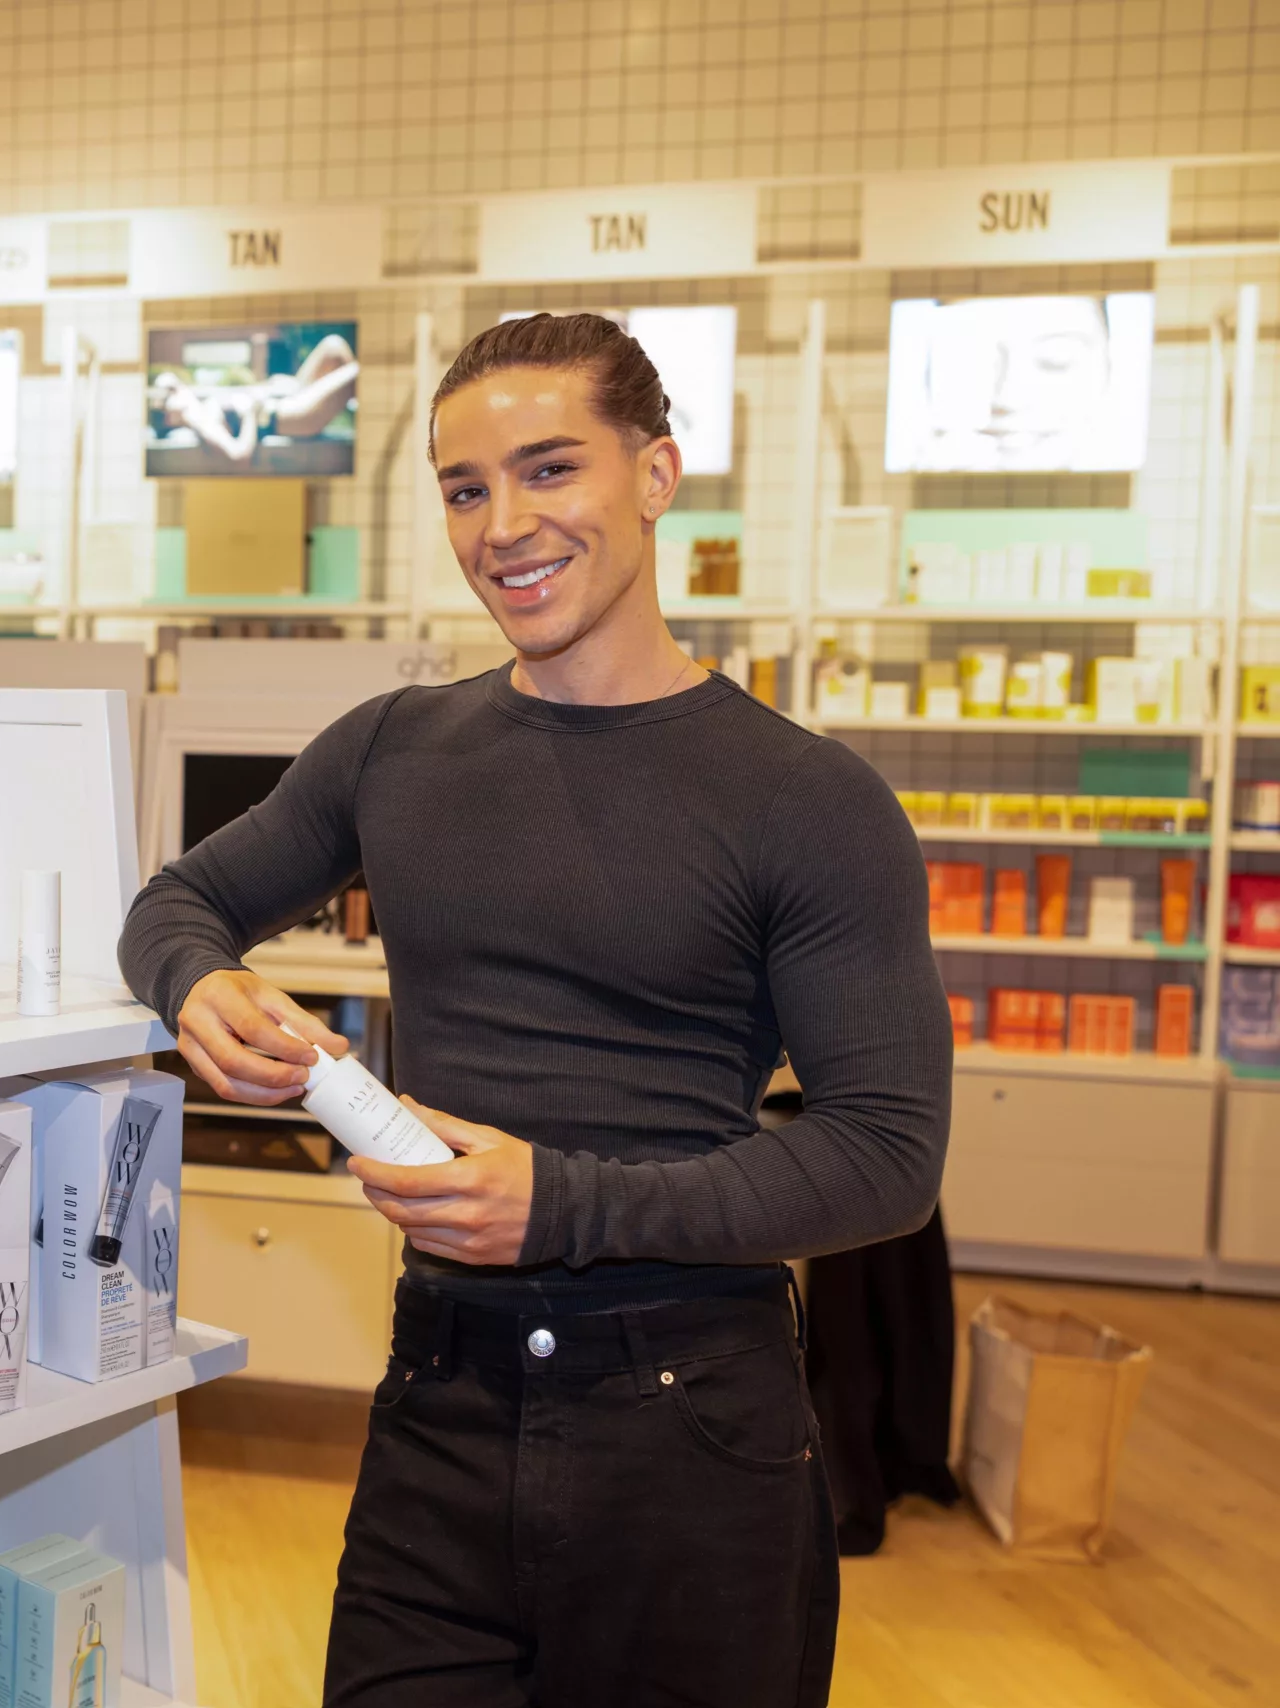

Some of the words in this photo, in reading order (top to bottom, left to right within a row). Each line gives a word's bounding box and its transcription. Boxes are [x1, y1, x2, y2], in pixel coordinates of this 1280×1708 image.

[978, 192, 1051, 233] SUN
[590, 212, 646, 253] TAN
[229, 228, 282, 269] TAN
[372, 1121, 392, 1142] RESCUE
[101, 1270, 125, 1283] DREAM
[101, 1279, 122, 1291] CLEAN
[101, 1297, 111, 1307] DE
